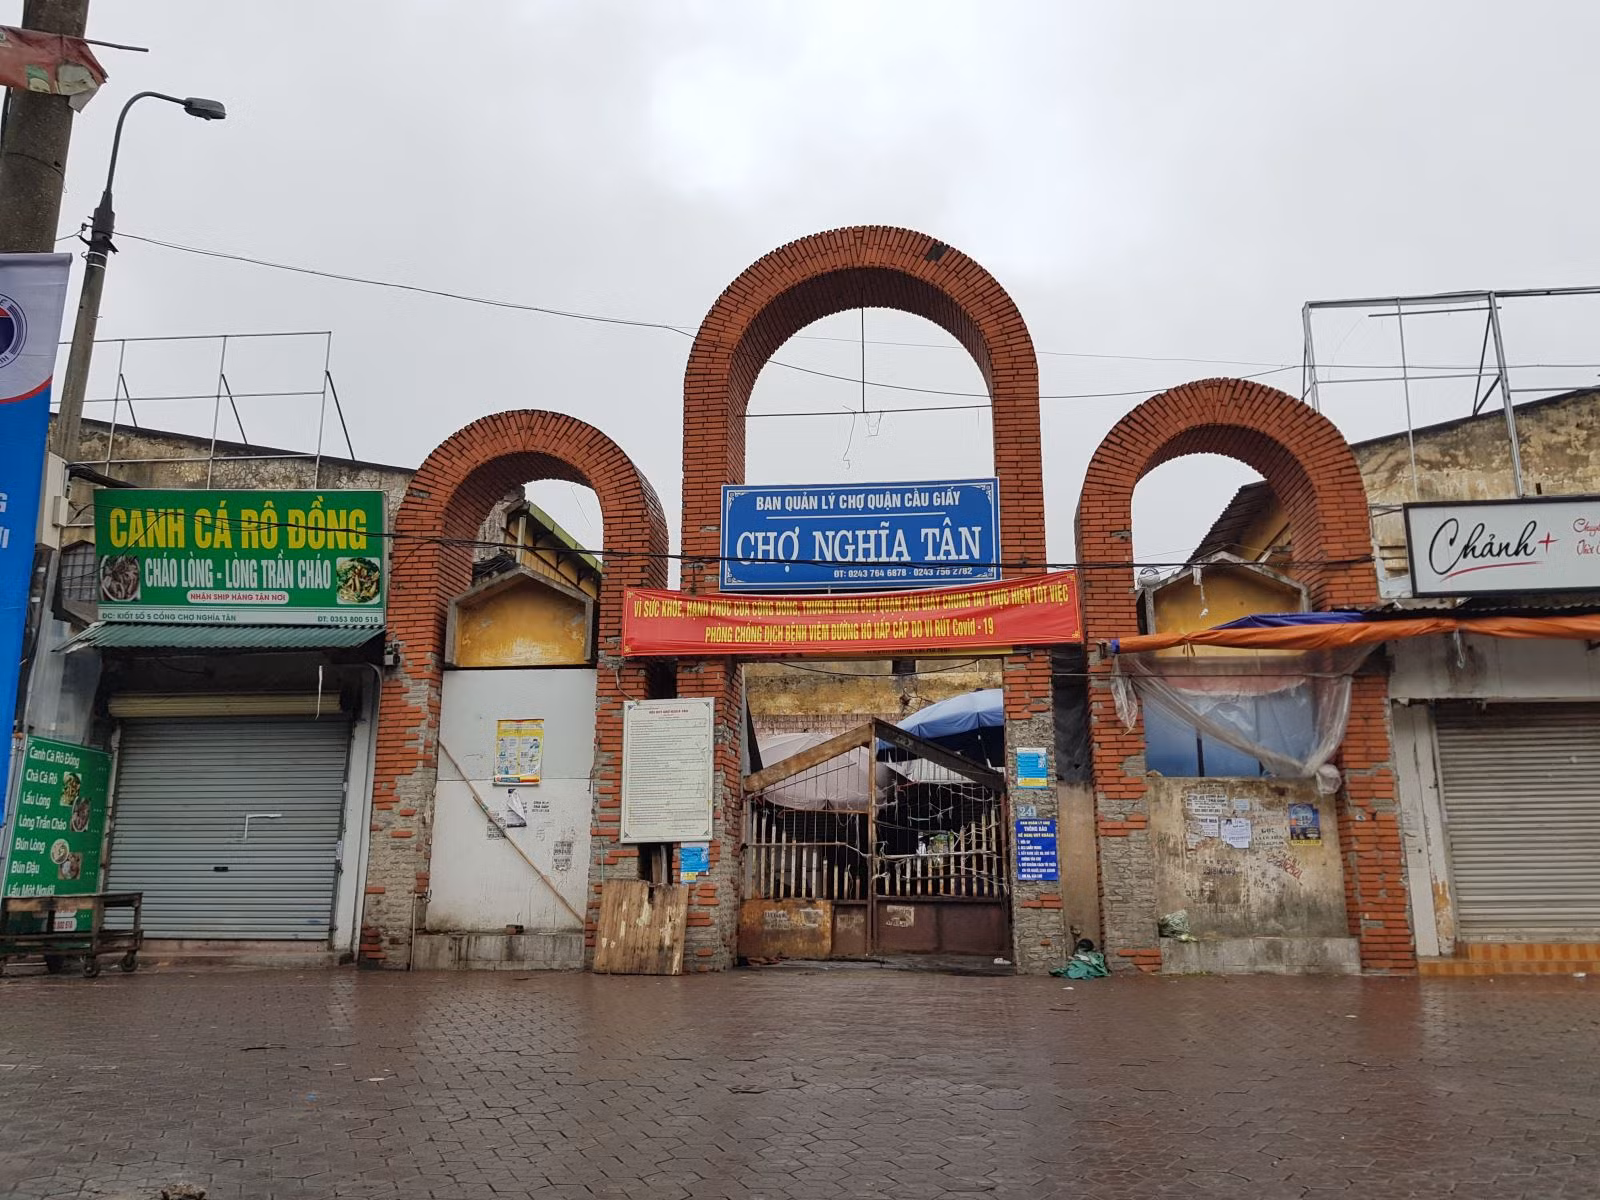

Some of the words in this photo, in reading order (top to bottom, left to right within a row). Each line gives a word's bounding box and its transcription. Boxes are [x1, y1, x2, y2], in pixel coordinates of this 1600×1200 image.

[756, 496, 782, 511] BAN
[784, 490, 818, 512] QUẢN
[821, 492, 836, 510] LÝ
[839, 493, 866, 511] CHỢ
[867, 490, 901, 511] QUẬN
[904, 488, 930, 508] CẦU
[932, 486, 961, 506] GIẤY
[109, 508, 185, 548] CANH
[195, 500, 232, 549] CÁ
[241, 500, 278, 549] RÔ
[287, 495, 367, 549] ĐỒNG
[735, 525, 800, 573] CHỢ
[812, 520, 911, 563] NGHĨA
[920, 516, 982, 561] TÂN
[144, 552, 178, 588] CHÁO
[181, 551, 214, 588] LÒNG
[225, 551, 258, 589] LÒNG
[261, 550, 294, 589] TRẦN
[297, 553, 332, 589] CHÁO
[848, 569, 868, 578] 0243
[869, 568, 885, 577] 764
[913, 567, 934, 576] 0243
[190, 592, 212, 602] NHẬN
[213, 593, 230, 601] SHIP
[231, 592, 254, 601] HÀNG
[255, 593, 270, 602] TẬN
[271, 593, 286, 601] NƠI
[633, 598, 642, 618] VÌ
[643, 597, 660, 618] SỨC
[686, 600, 709, 621] HẠNH
[710, 599, 732, 617] PHÚC
[734, 597, 750, 616] CỦA
[942, 592, 971, 610] CHUNG
[972, 591, 987, 607] TAY
[988, 587, 1010, 609] THỰC
[1011, 585, 1031, 608] HIỆN
[1032, 581, 1048, 604] TỐT
[1049, 580, 1069, 606] VIỆC
[177, 613, 195, 622] CHỢ
[195, 612, 220, 622] NGHĨA
[221, 613, 237, 622] TÂN
[330, 615, 348, 623] 0353
[704, 622, 733, 644] PHÒNG
[735, 620, 763, 643] CHỐNG
[785, 621, 807, 646] BỆNH
[808, 621, 829, 641] VIÊM
[831, 619, 860, 641] ĐƯỜNG
[861, 620, 873, 640] HÔ
[874, 616, 891, 639] HẤP
[892, 615, 910, 639] CẤP
[911, 619, 923, 638] DO
[924, 619, 934, 638] VI
[935, 615, 951, 637] RÚT
[952, 617, 976, 637] Covid
[983, 617, 994, 635] 19
[29, 746, 46, 761] Canh
[46, 749, 55, 762] Cá
[39, 771, 48, 784] Cá
[15, 837, 29, 850] Bún
[11, 861, 25, 874] Bún
